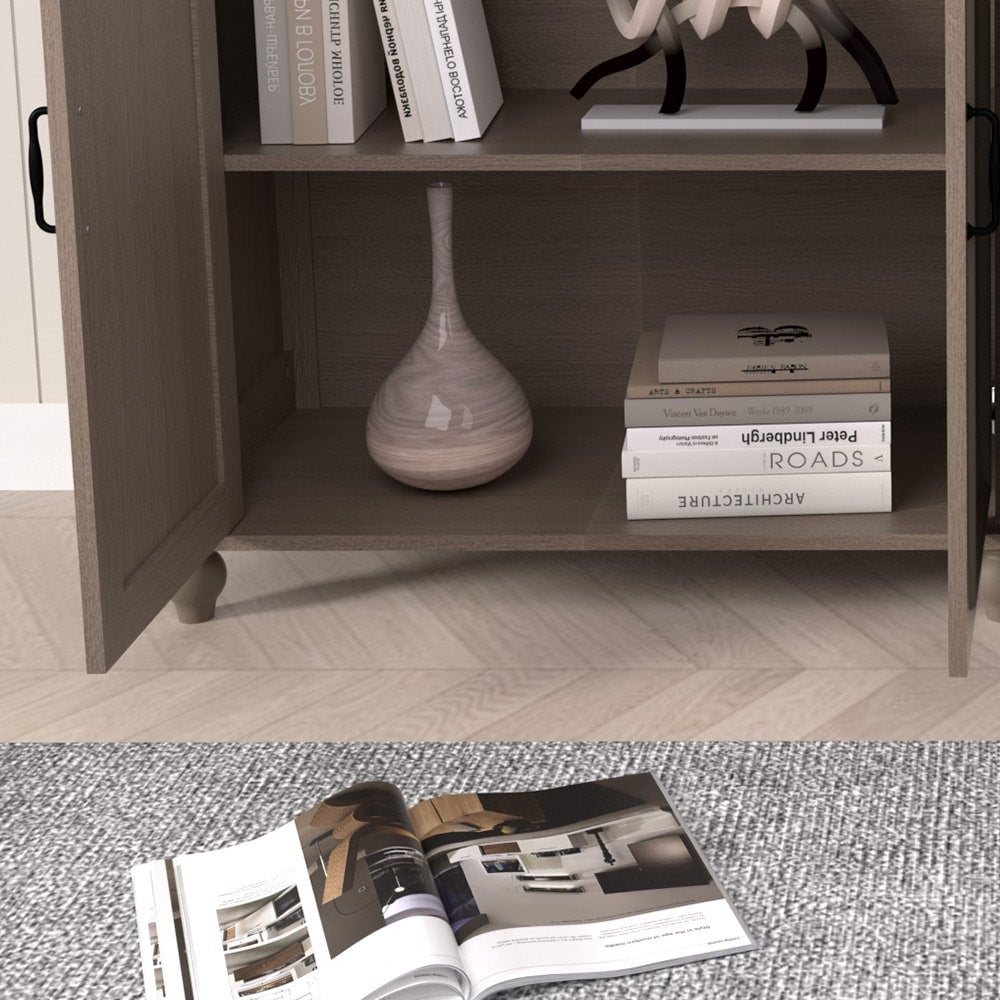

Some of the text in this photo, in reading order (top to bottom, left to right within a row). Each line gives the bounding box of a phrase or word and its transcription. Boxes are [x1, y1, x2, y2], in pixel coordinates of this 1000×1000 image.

[663, 408, 737, 419] Vincent Van Duysen
[742, 430, 858, 444] Peter Lindbergh
[770, 450, 864, 469] ROADS
[678, 492, 806, 508] ARCHITECTURE
